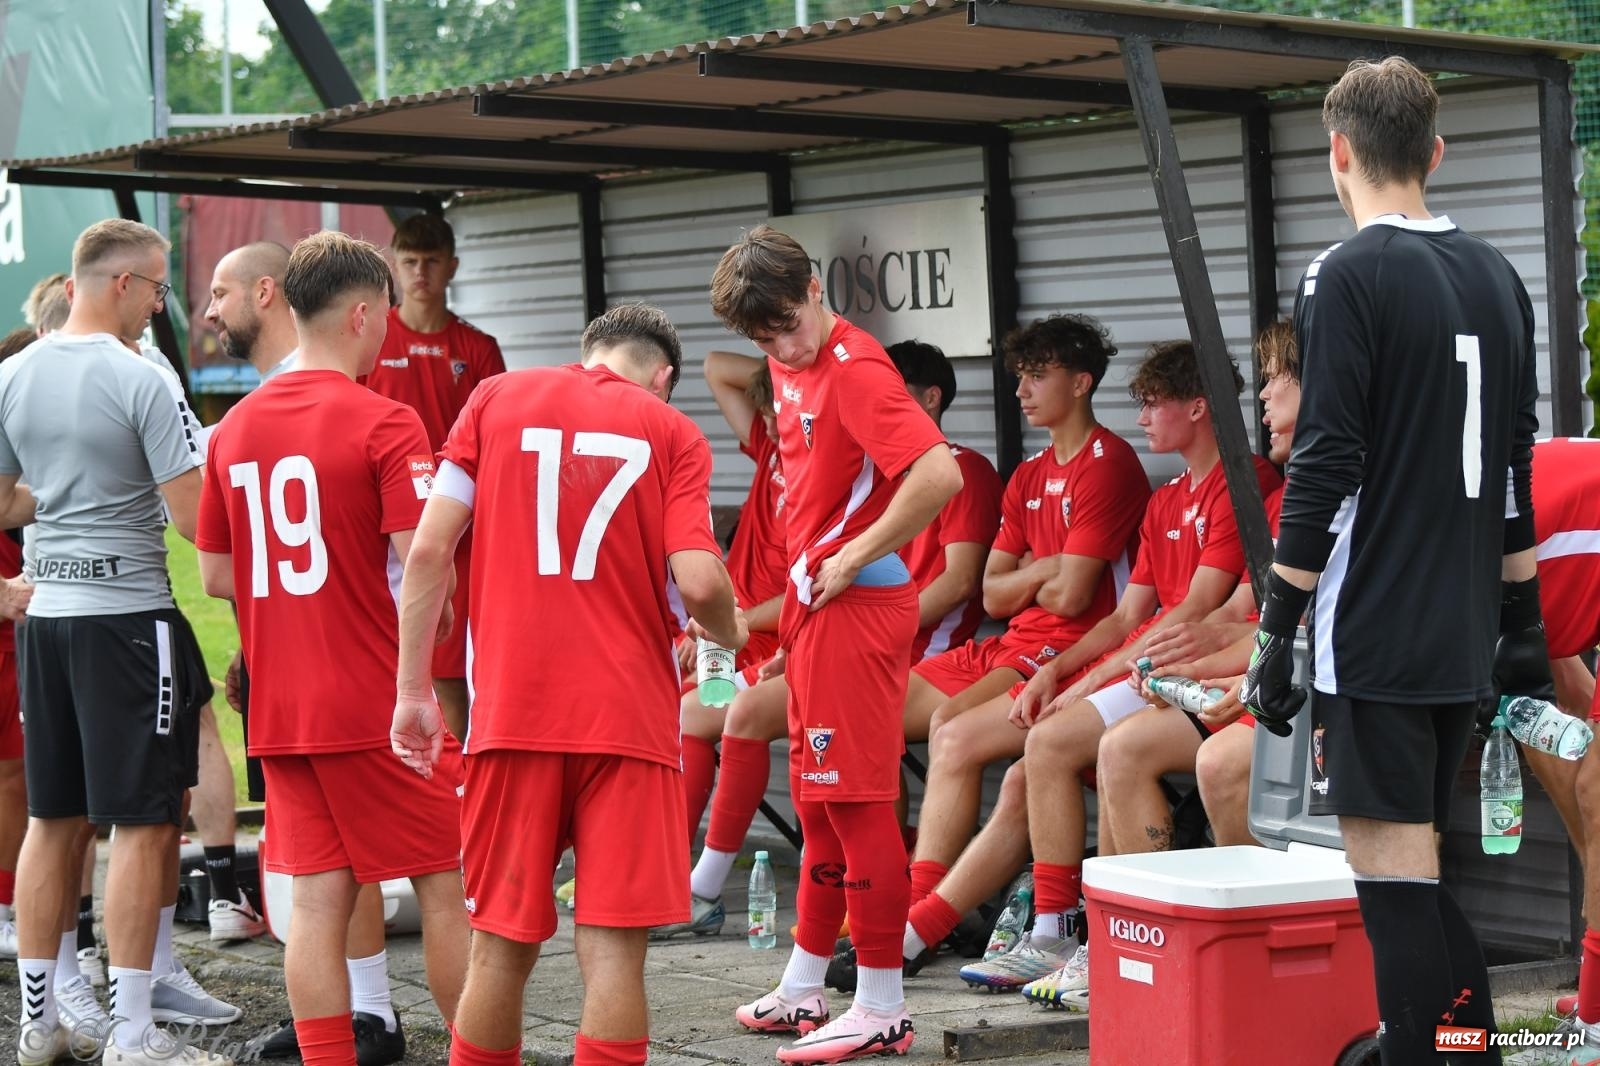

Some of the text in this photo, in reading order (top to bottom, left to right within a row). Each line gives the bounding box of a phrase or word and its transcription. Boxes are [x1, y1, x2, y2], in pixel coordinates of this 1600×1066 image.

[1455, 334, 1482, 498] 1
[228, 454, 329, 598] 19
[521, 427, 652, 581] 17
[36, 556, 121, 579] UPERBET
[801, 770, 839, 782] capelli
[1109, 916, 1165, 947] IGLOO
